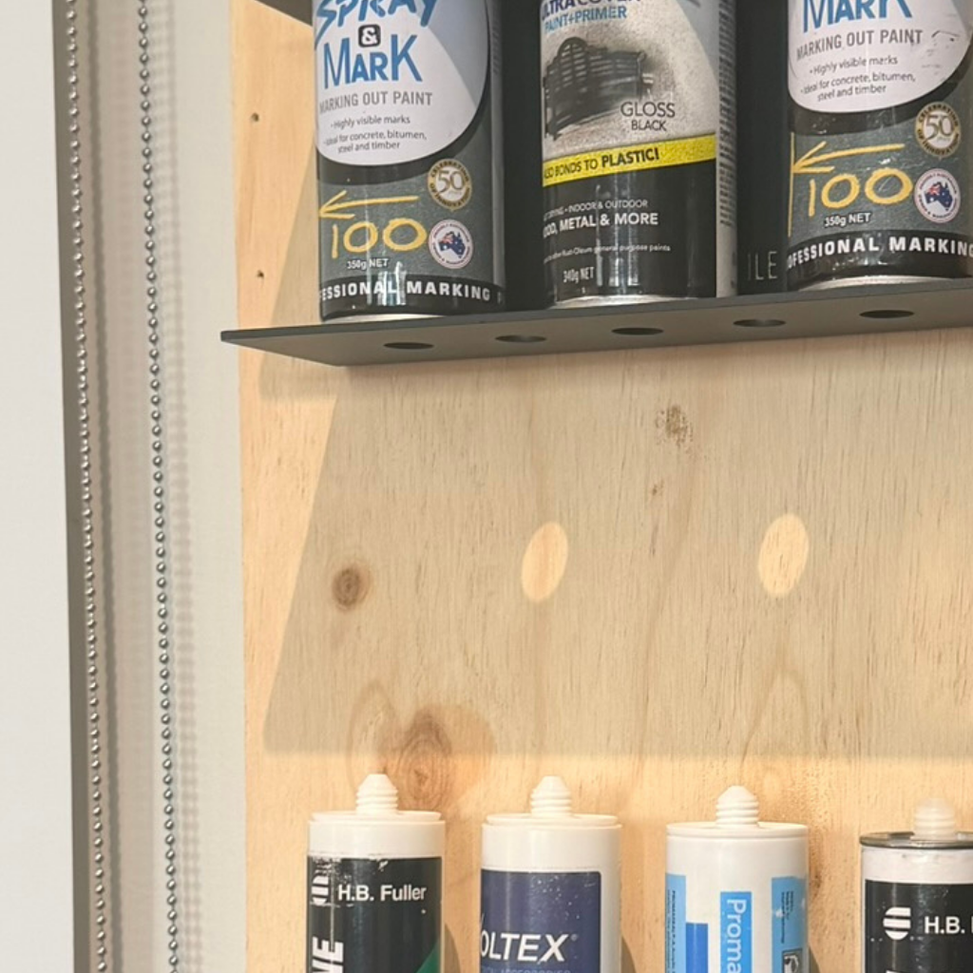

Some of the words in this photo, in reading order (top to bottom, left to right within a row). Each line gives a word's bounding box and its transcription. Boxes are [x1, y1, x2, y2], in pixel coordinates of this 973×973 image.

[361, 27, 378, 46] &
[797, 34, 842, 61] MARKING
[846, 30, 875, 46] OUT
[880, 29, 923, 44] PAINT
[323, 34, 423, 89] MARK
[813, 63, 838, 76] Highly
[839, 57, 867, 69] visible
[868, 55, 898, 66] marks
[830, 73, 872, 87] concrete,
[872, 72, 917, 83] bitumen,
[836, 86, 853, 97] and
[854, 84, 887, 95] timber
[319, 93, 359, 113] MARKING
[362, 91, 388, 106] OUT
[393, 91, 433, 106] PAINT
[620, 101, 676, 118] GLOSS
[356, 115, 382, 125] visible
[383, 115, 411, 124] marks
[630, 120, 667, 132] BLACK
[386, 130, 427, 140] bitumen,
[371, 141, 401, 150] timber
[583, 159, 599, 171] TO
[601, 148, 660, 168] PLASTIC!
[808, 167, 915, 217] 100
[604, 200, 649, 210] OUTDOOR
[559, 214, 597, 231] METAL
[599, 213, 610, 226] &
[614, 212, 659, 225] MORE
[823, 216, 848, 228] 350g
[848, 212, 872, 224] NET
[331, 217, 427, 259] 100
[368, 258, 389, 268] NET
[580, 266, 595, 280] NET
[318, 281, 398, 300] ESSIONAL
[406, 281, 491, 301] MARKING
[337, 884, 375, 902] H.B.
[380, 883, 428, 902] Fuller
[924, 916, 965, 934] H.B.
